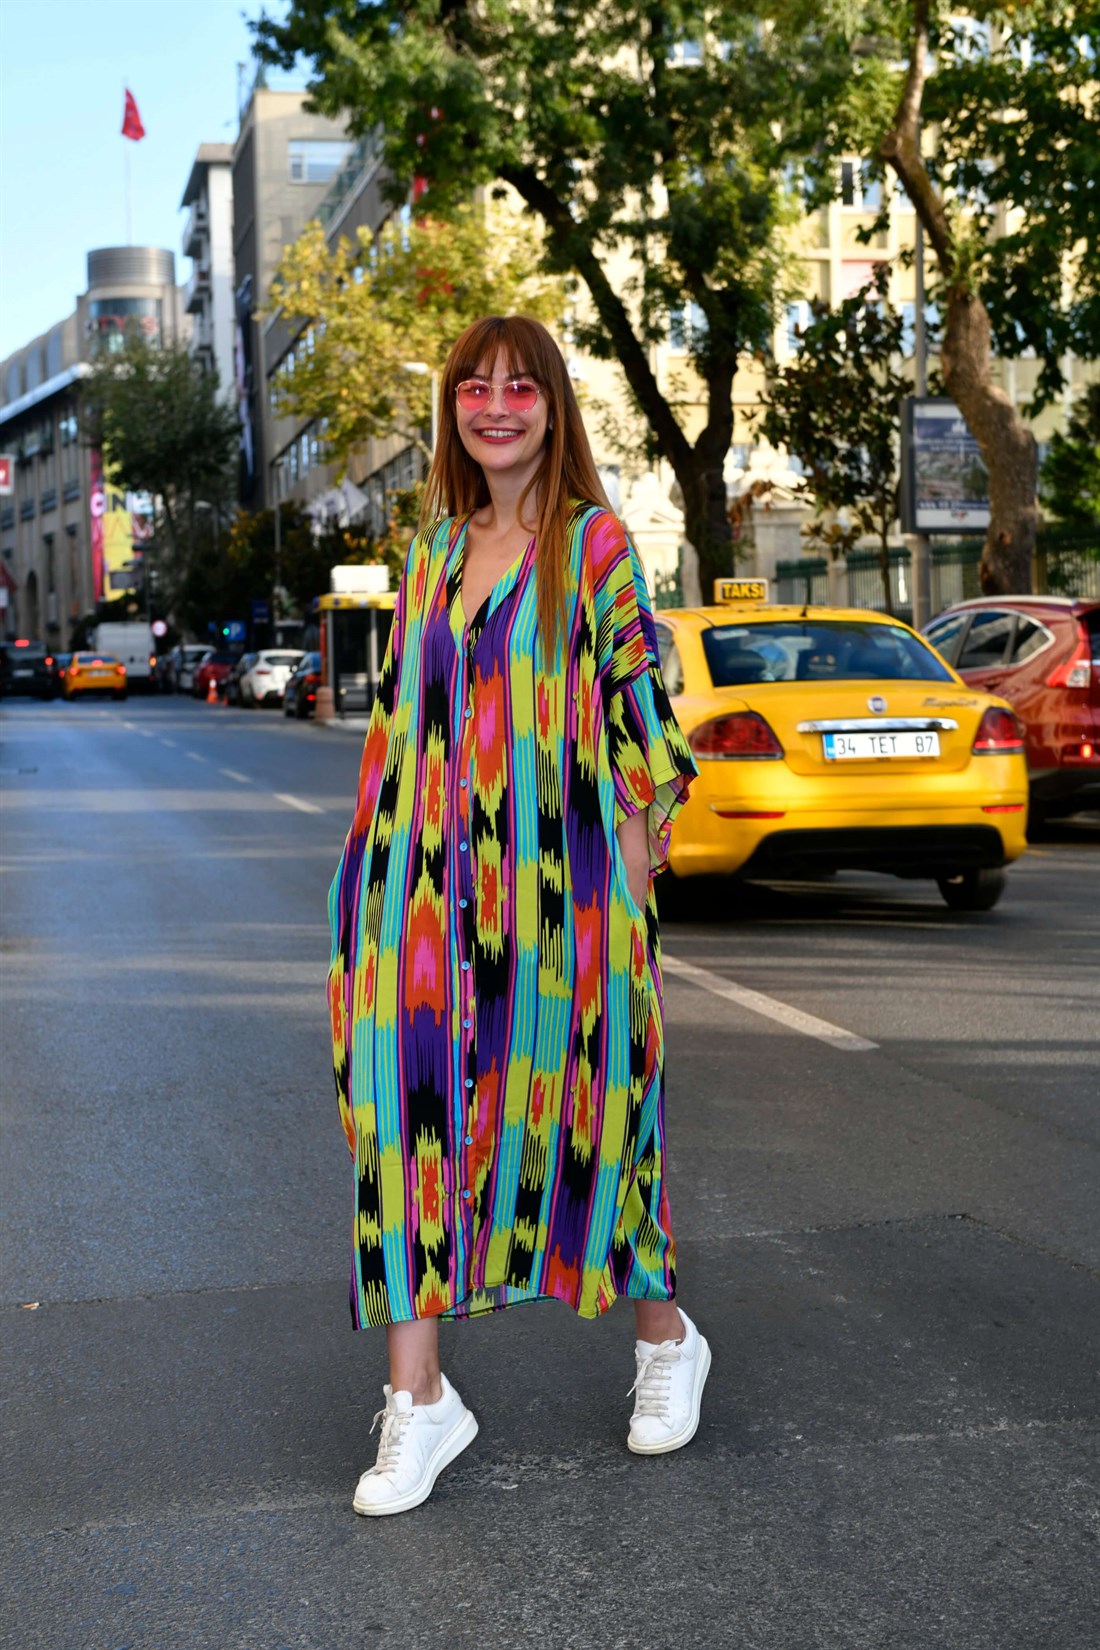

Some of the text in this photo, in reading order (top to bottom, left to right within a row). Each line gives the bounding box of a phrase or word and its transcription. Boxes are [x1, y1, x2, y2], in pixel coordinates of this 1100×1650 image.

[837, 738, 856, 755] 34
[868, 736, 897, 754] TET
[915, 736, 933, 753] 87
